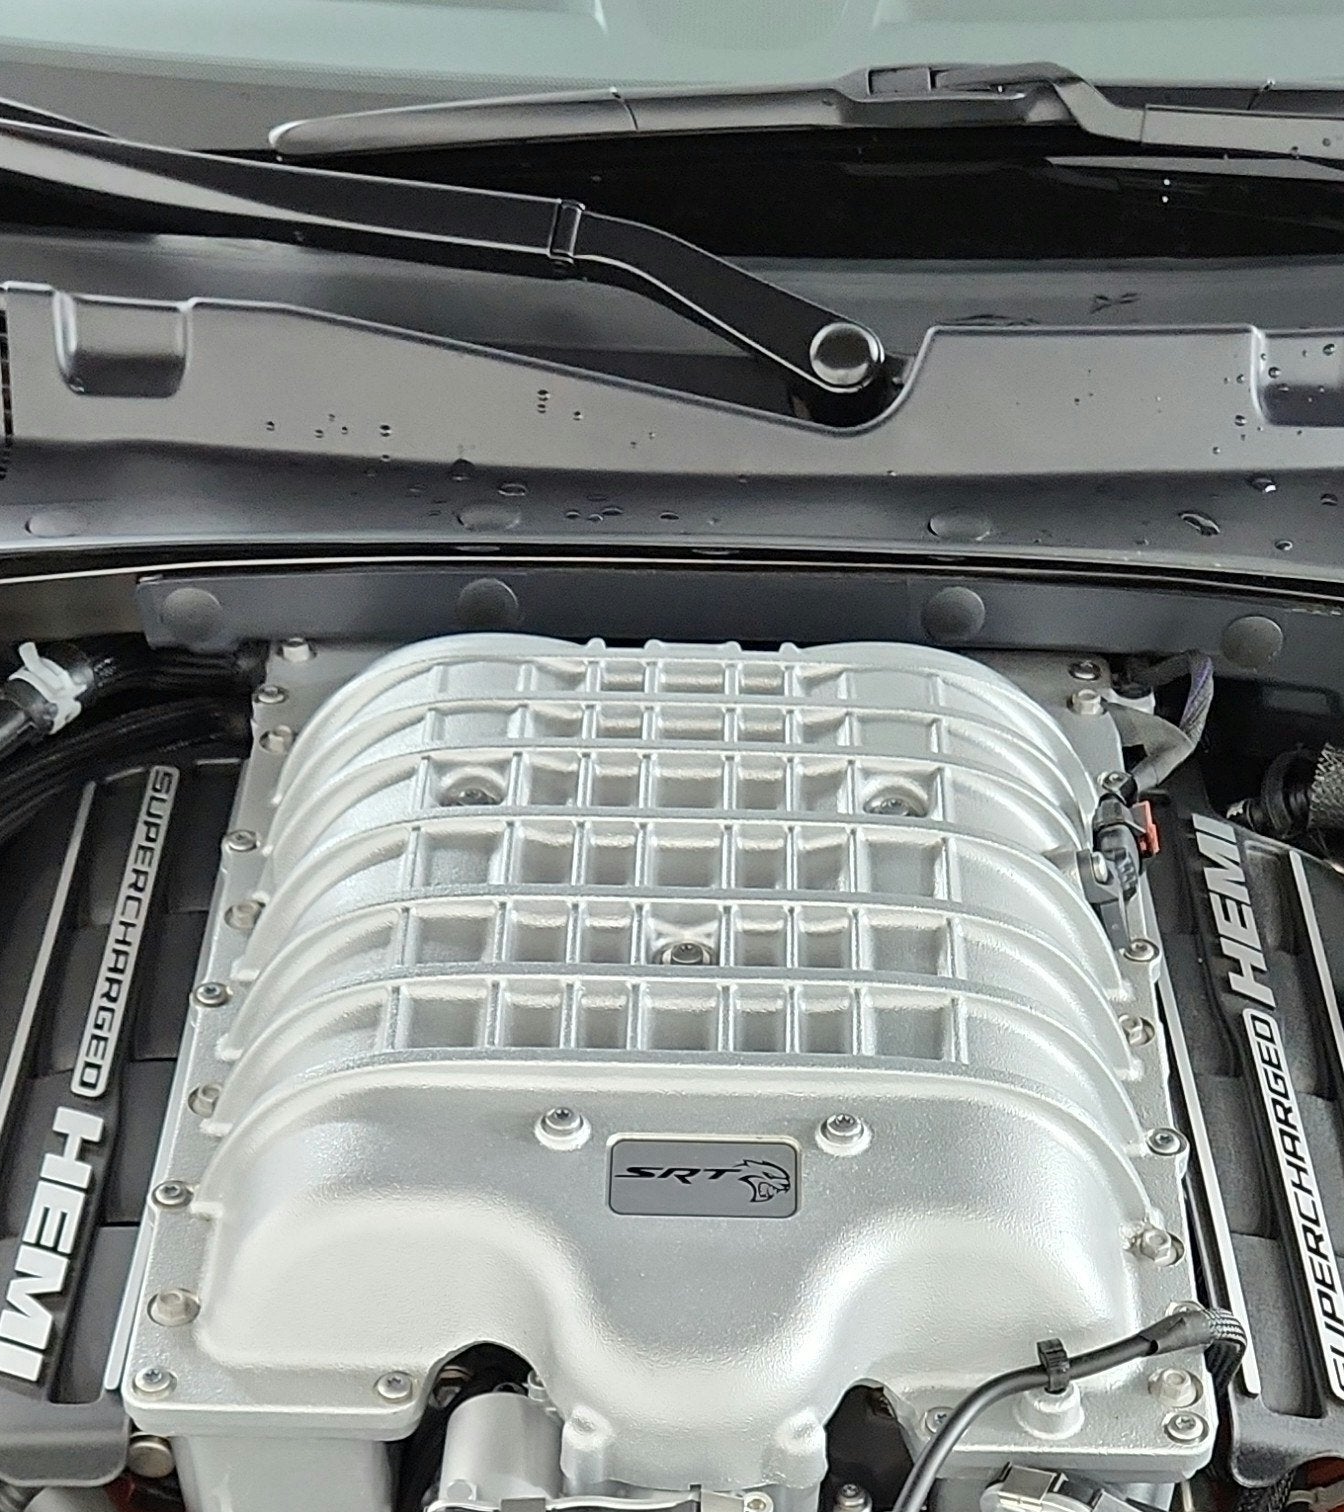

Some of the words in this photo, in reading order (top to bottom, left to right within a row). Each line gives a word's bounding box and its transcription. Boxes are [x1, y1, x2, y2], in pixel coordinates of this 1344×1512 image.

[78, 768, 175, 1091] SUPERCHARGED
[1191, 813, 1277, 1008] HEMI
[613, 1166, 743, 1185] SRT
